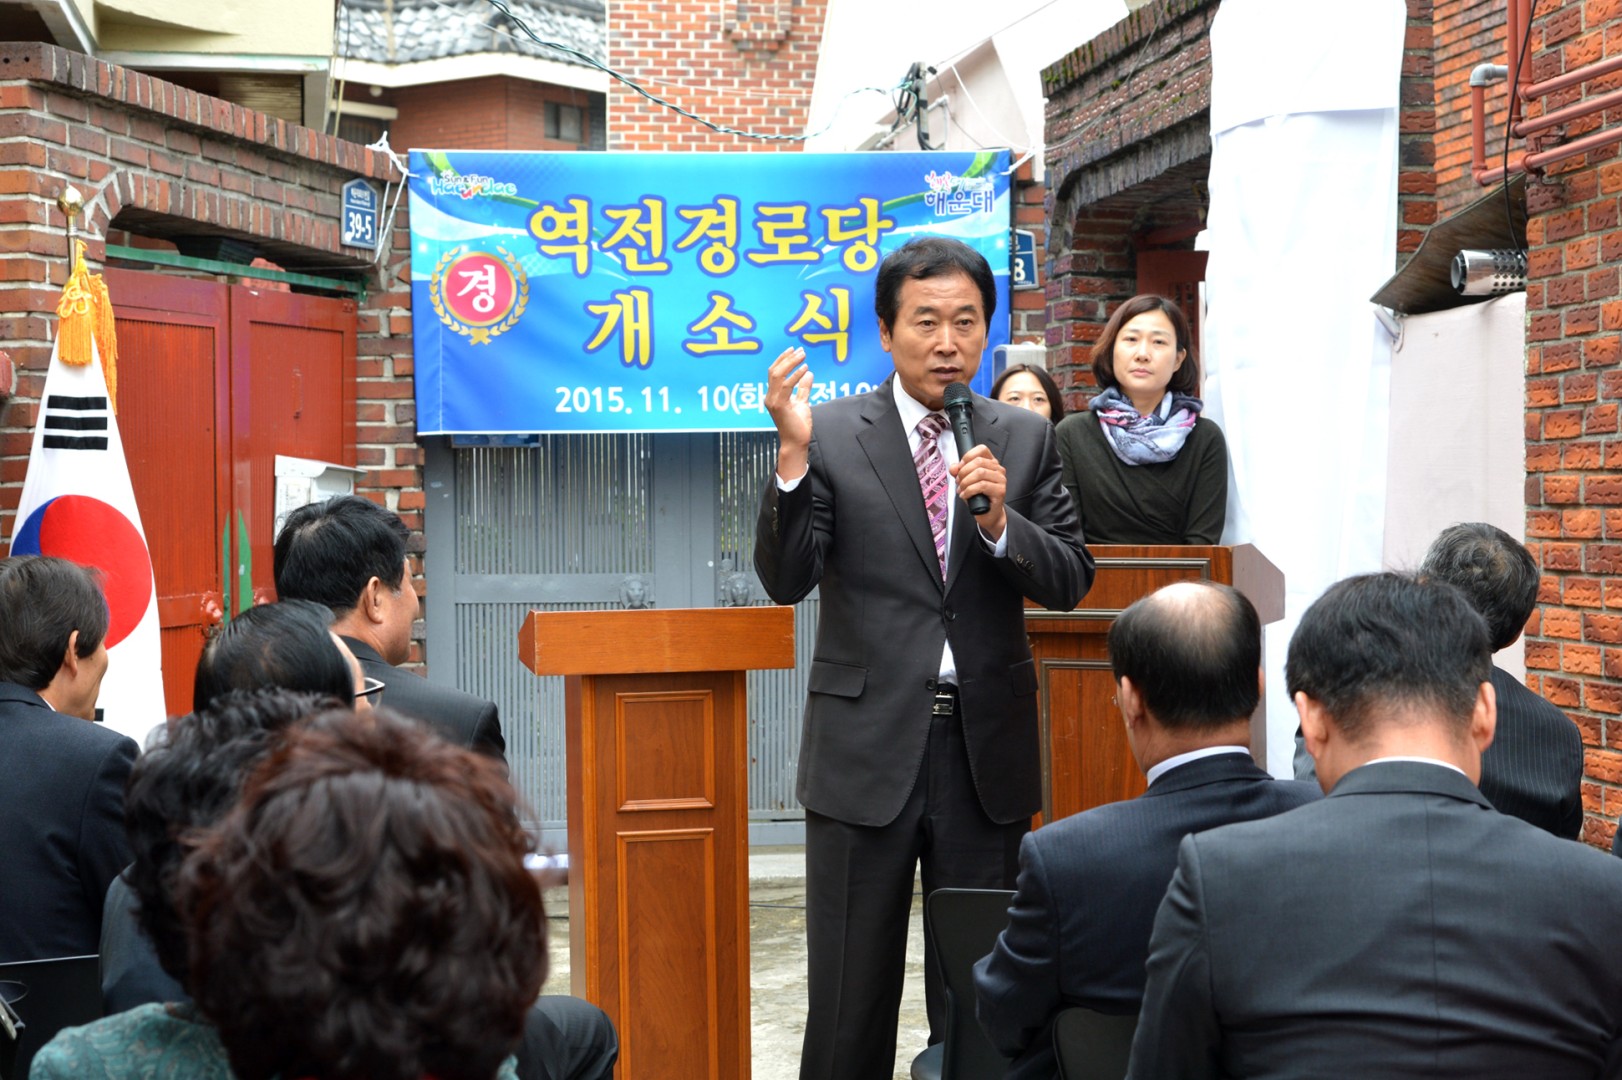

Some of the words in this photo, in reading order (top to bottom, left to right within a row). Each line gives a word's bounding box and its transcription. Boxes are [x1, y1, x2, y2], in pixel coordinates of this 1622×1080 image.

[431, 176, 517, 199] Haeundae
[925, 190, 994, 215] 해운대
[348, 211, 372, 240] 39-5
[529, 197, 894, 276] 역전경로당
[456, 264, 497, 314] 경
[554, 386, 634, 415] 2015.
